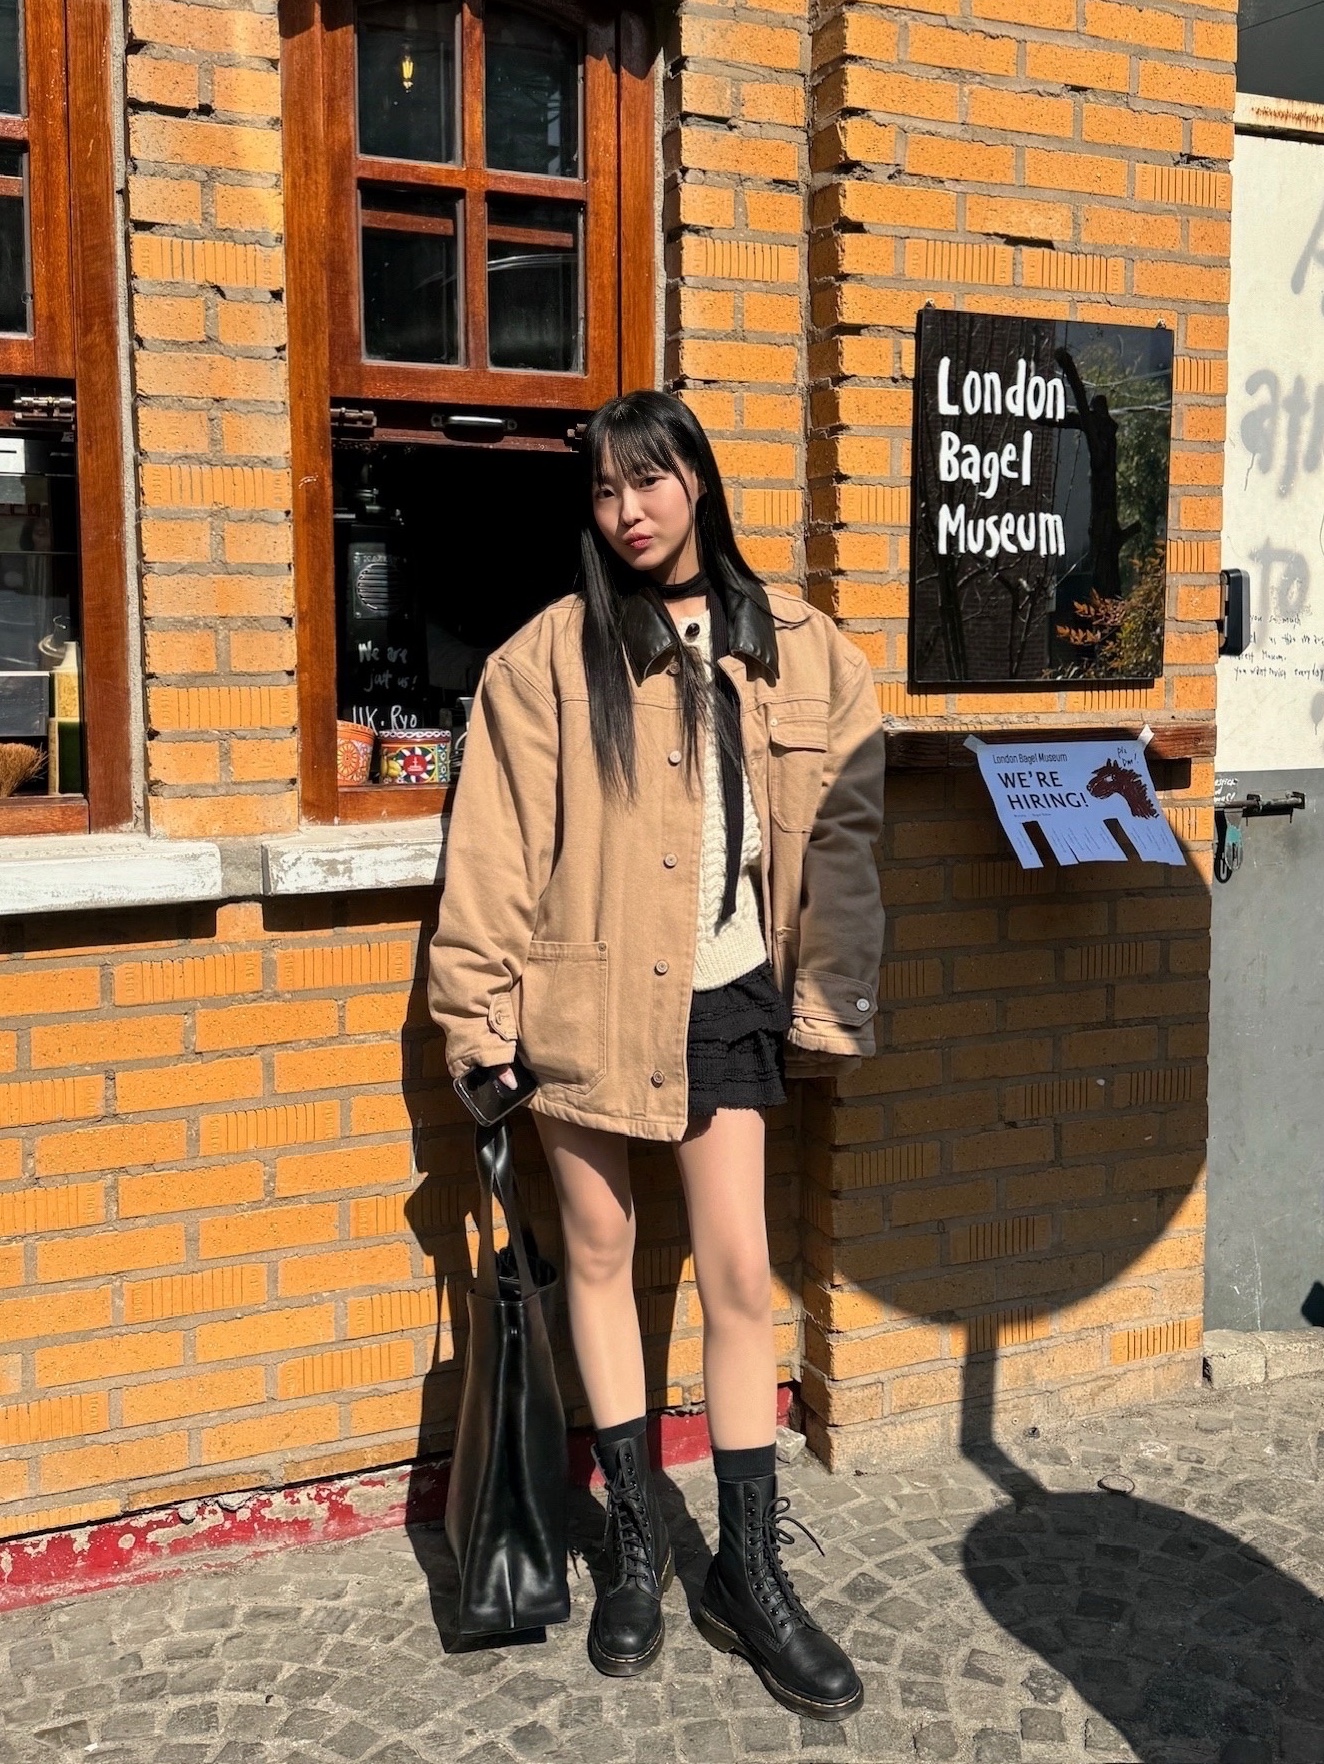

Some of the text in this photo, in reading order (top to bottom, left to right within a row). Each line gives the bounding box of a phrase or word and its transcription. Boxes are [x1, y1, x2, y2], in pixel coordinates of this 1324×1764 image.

[938, 356, 1066, 421] London
[938, 430, 1033, 500] Bagel
[938, 503, 1066, 559] Museum
[358, 640, 408, 664] We are
[390, 704, 418, 732] Ryo
[992, 752, 1068, 765] London Bagel Museum
[1007, 792, 1090, 811] HIRING!
